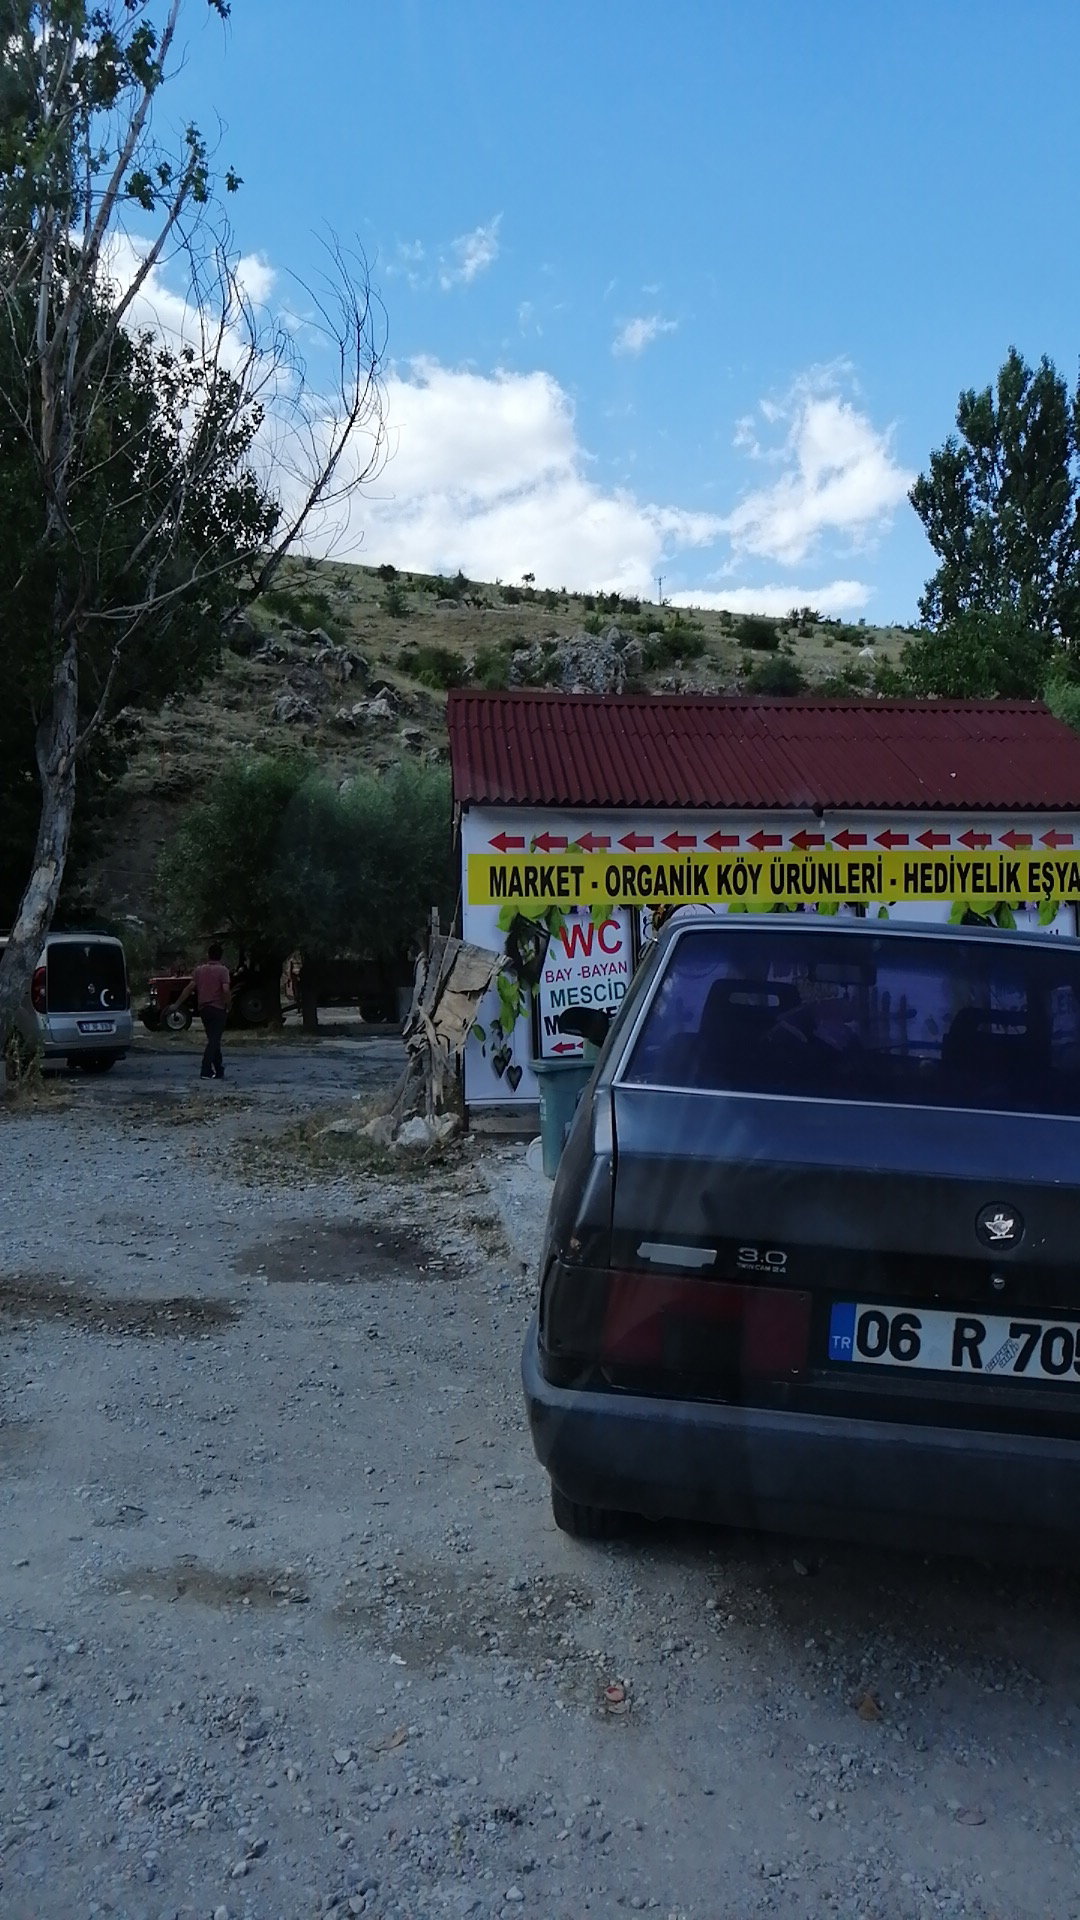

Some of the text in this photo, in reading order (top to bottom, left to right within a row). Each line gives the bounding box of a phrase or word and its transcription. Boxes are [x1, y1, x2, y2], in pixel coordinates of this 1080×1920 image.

[489, 865, 585, 897] MARKET
[605, 857, 709, 897] ORGANİK
[717, 857, 762, 895] KÖY
[770, 855, 883, 895] ÜRÜNLERİ
[904, 855, 1021, 894] HEDİYELİK
[1028, 861, 1080, 901] EŞYA
[559, 920, 623, 959] WC
[545, 967, 573, 983] BAY
[550, 978, 627, 1008] MESCİD
[738, 1247, 788, 1265] 3.0
[832, 1335, 851, 1349] TR
[857, 1310, 922, 1361] 06
[952, 1317, 986, 1369] R
